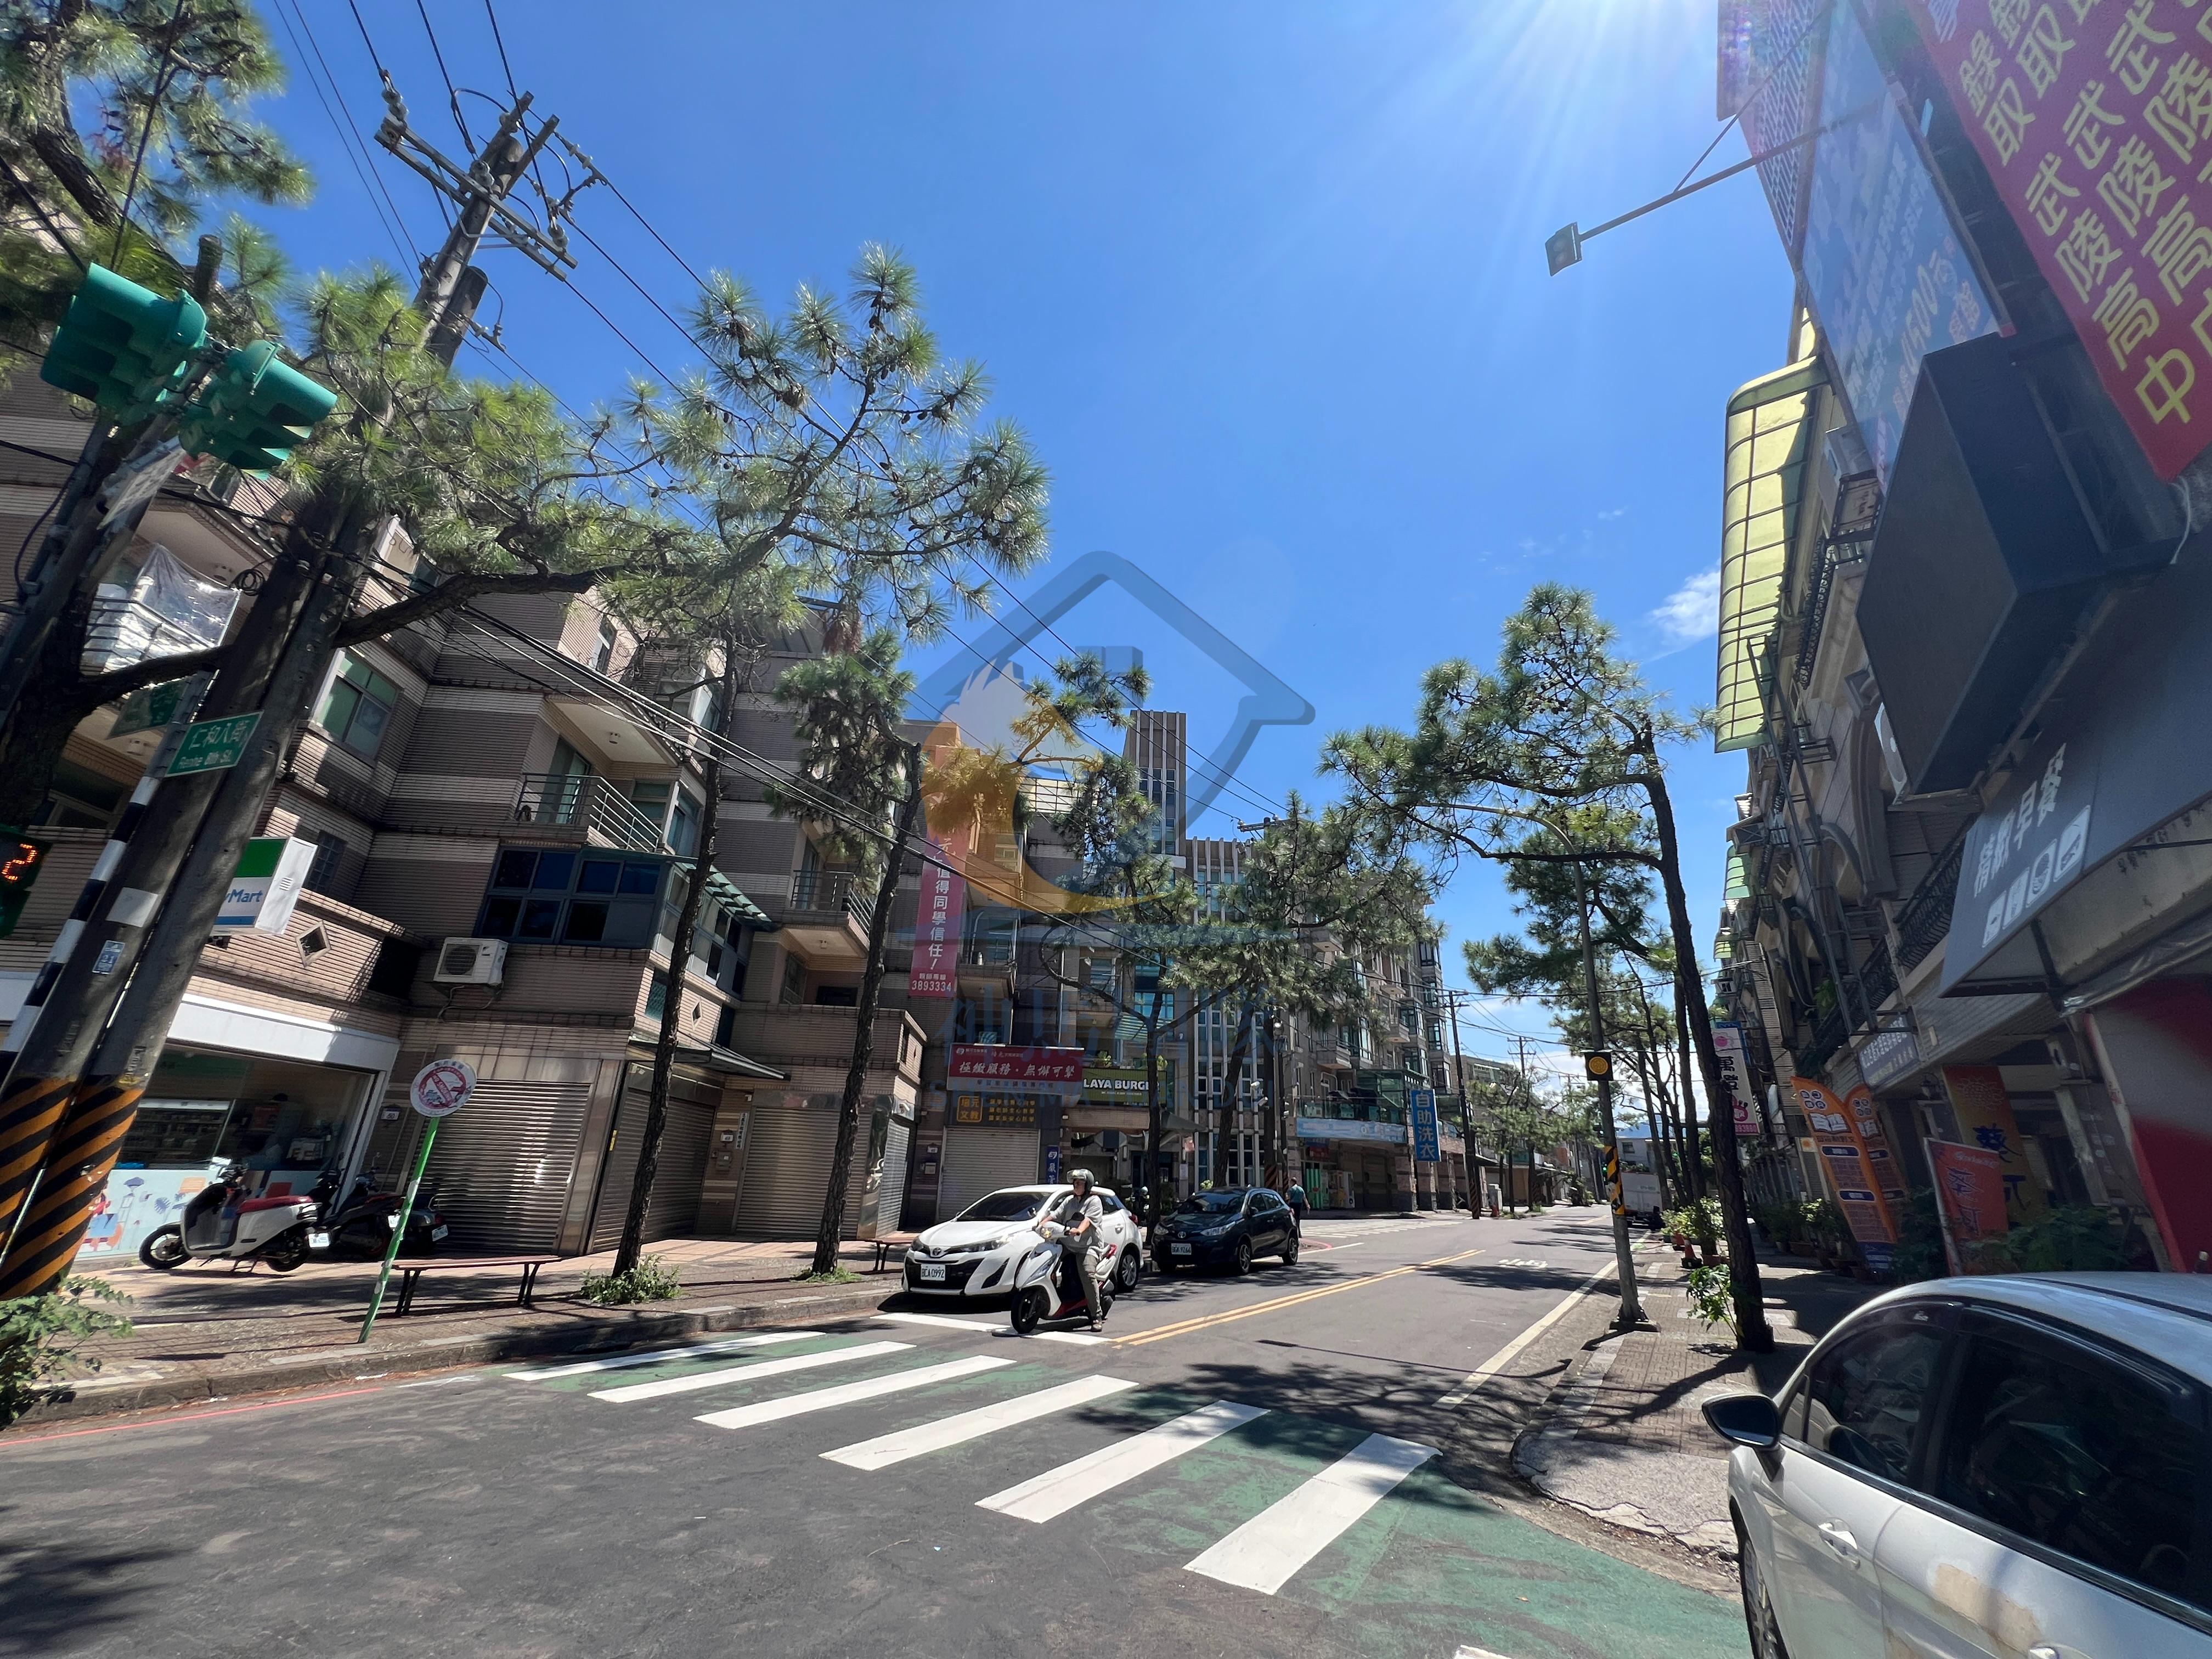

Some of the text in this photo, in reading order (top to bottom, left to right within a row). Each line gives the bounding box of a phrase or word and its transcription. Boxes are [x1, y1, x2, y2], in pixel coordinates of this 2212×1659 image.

[1959, 30, 2195, 425] 錄取武陵高中
[911, 980, 952, 992] 3893334
[1083, 1078, 1160, 1091] LAYA BURG
[1415, 1093, 1436, 1159] 自助洗衣
